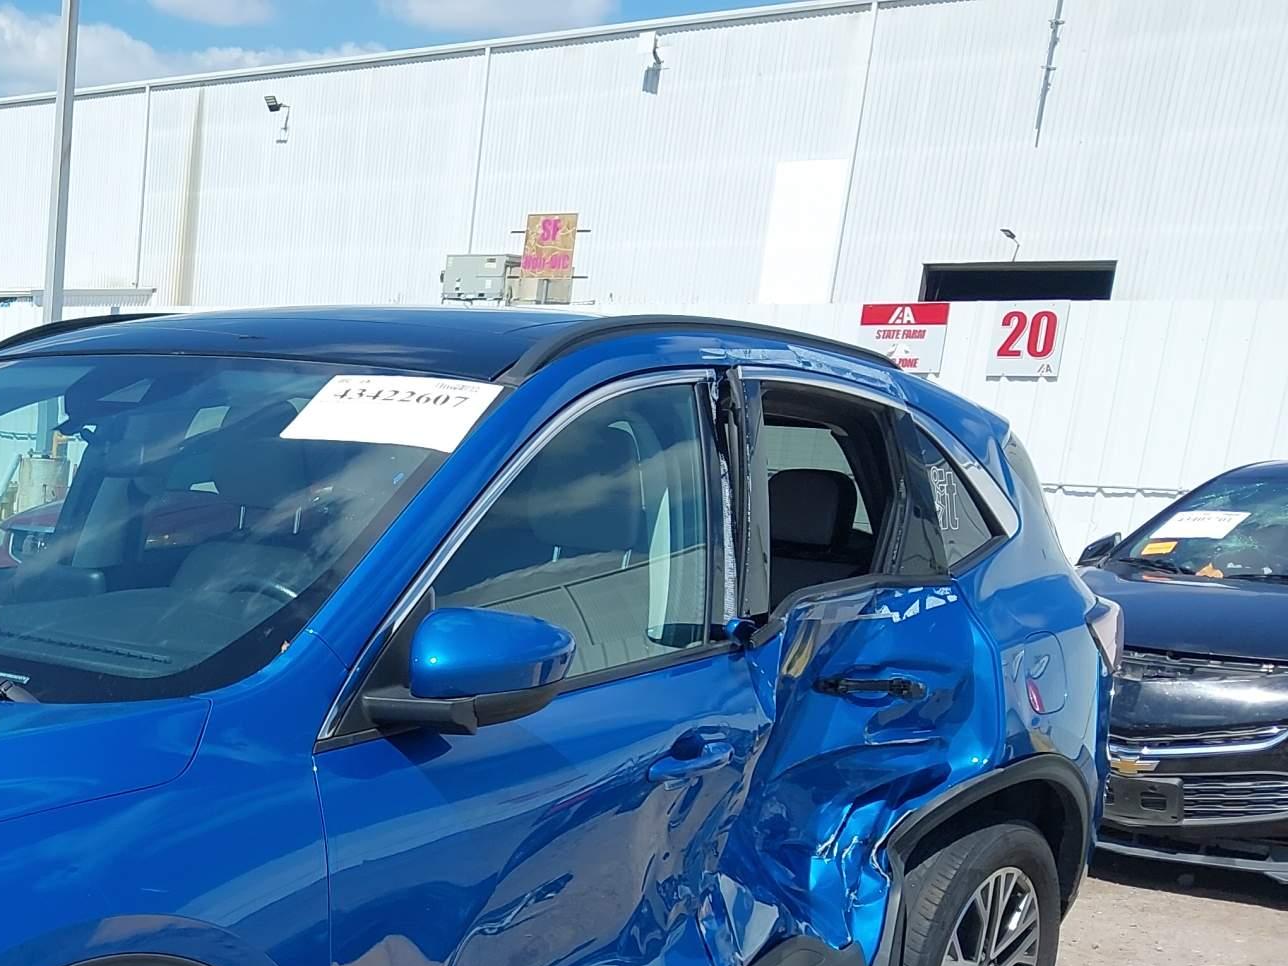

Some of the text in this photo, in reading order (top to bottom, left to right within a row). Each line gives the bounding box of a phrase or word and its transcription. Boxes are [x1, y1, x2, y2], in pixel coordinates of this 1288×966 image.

[541, 219, 561, 241] SF
[875, 328, 927, 340] STATE FARM
[996, 310, 1059, 359] 20
[898, 358, 920, 369] ZONE
[333, 387, 471, 409] 43422607
